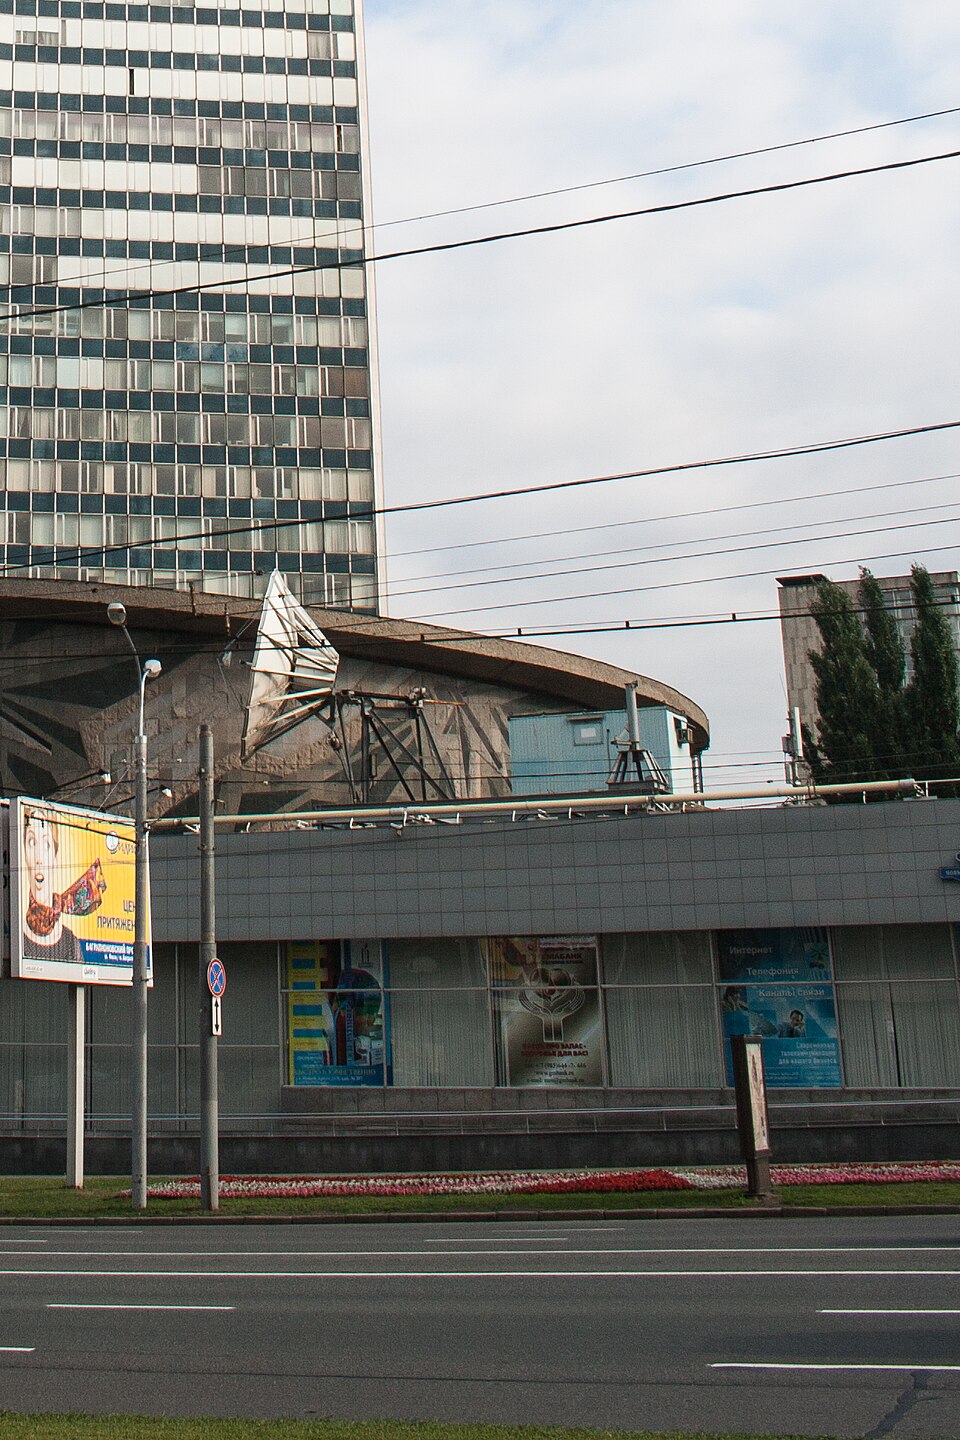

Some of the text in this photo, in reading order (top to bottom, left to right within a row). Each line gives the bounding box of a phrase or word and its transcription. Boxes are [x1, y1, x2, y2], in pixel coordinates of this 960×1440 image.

[123, 900, 136, 914] ЦЕН
[97, 915, 136, 932] ПРИТЯЖЕН
[729, 946, 773, 956] Интернет
[746, 966, 799, 977] Телефония
[758, 988, 796, 997] Каналы
